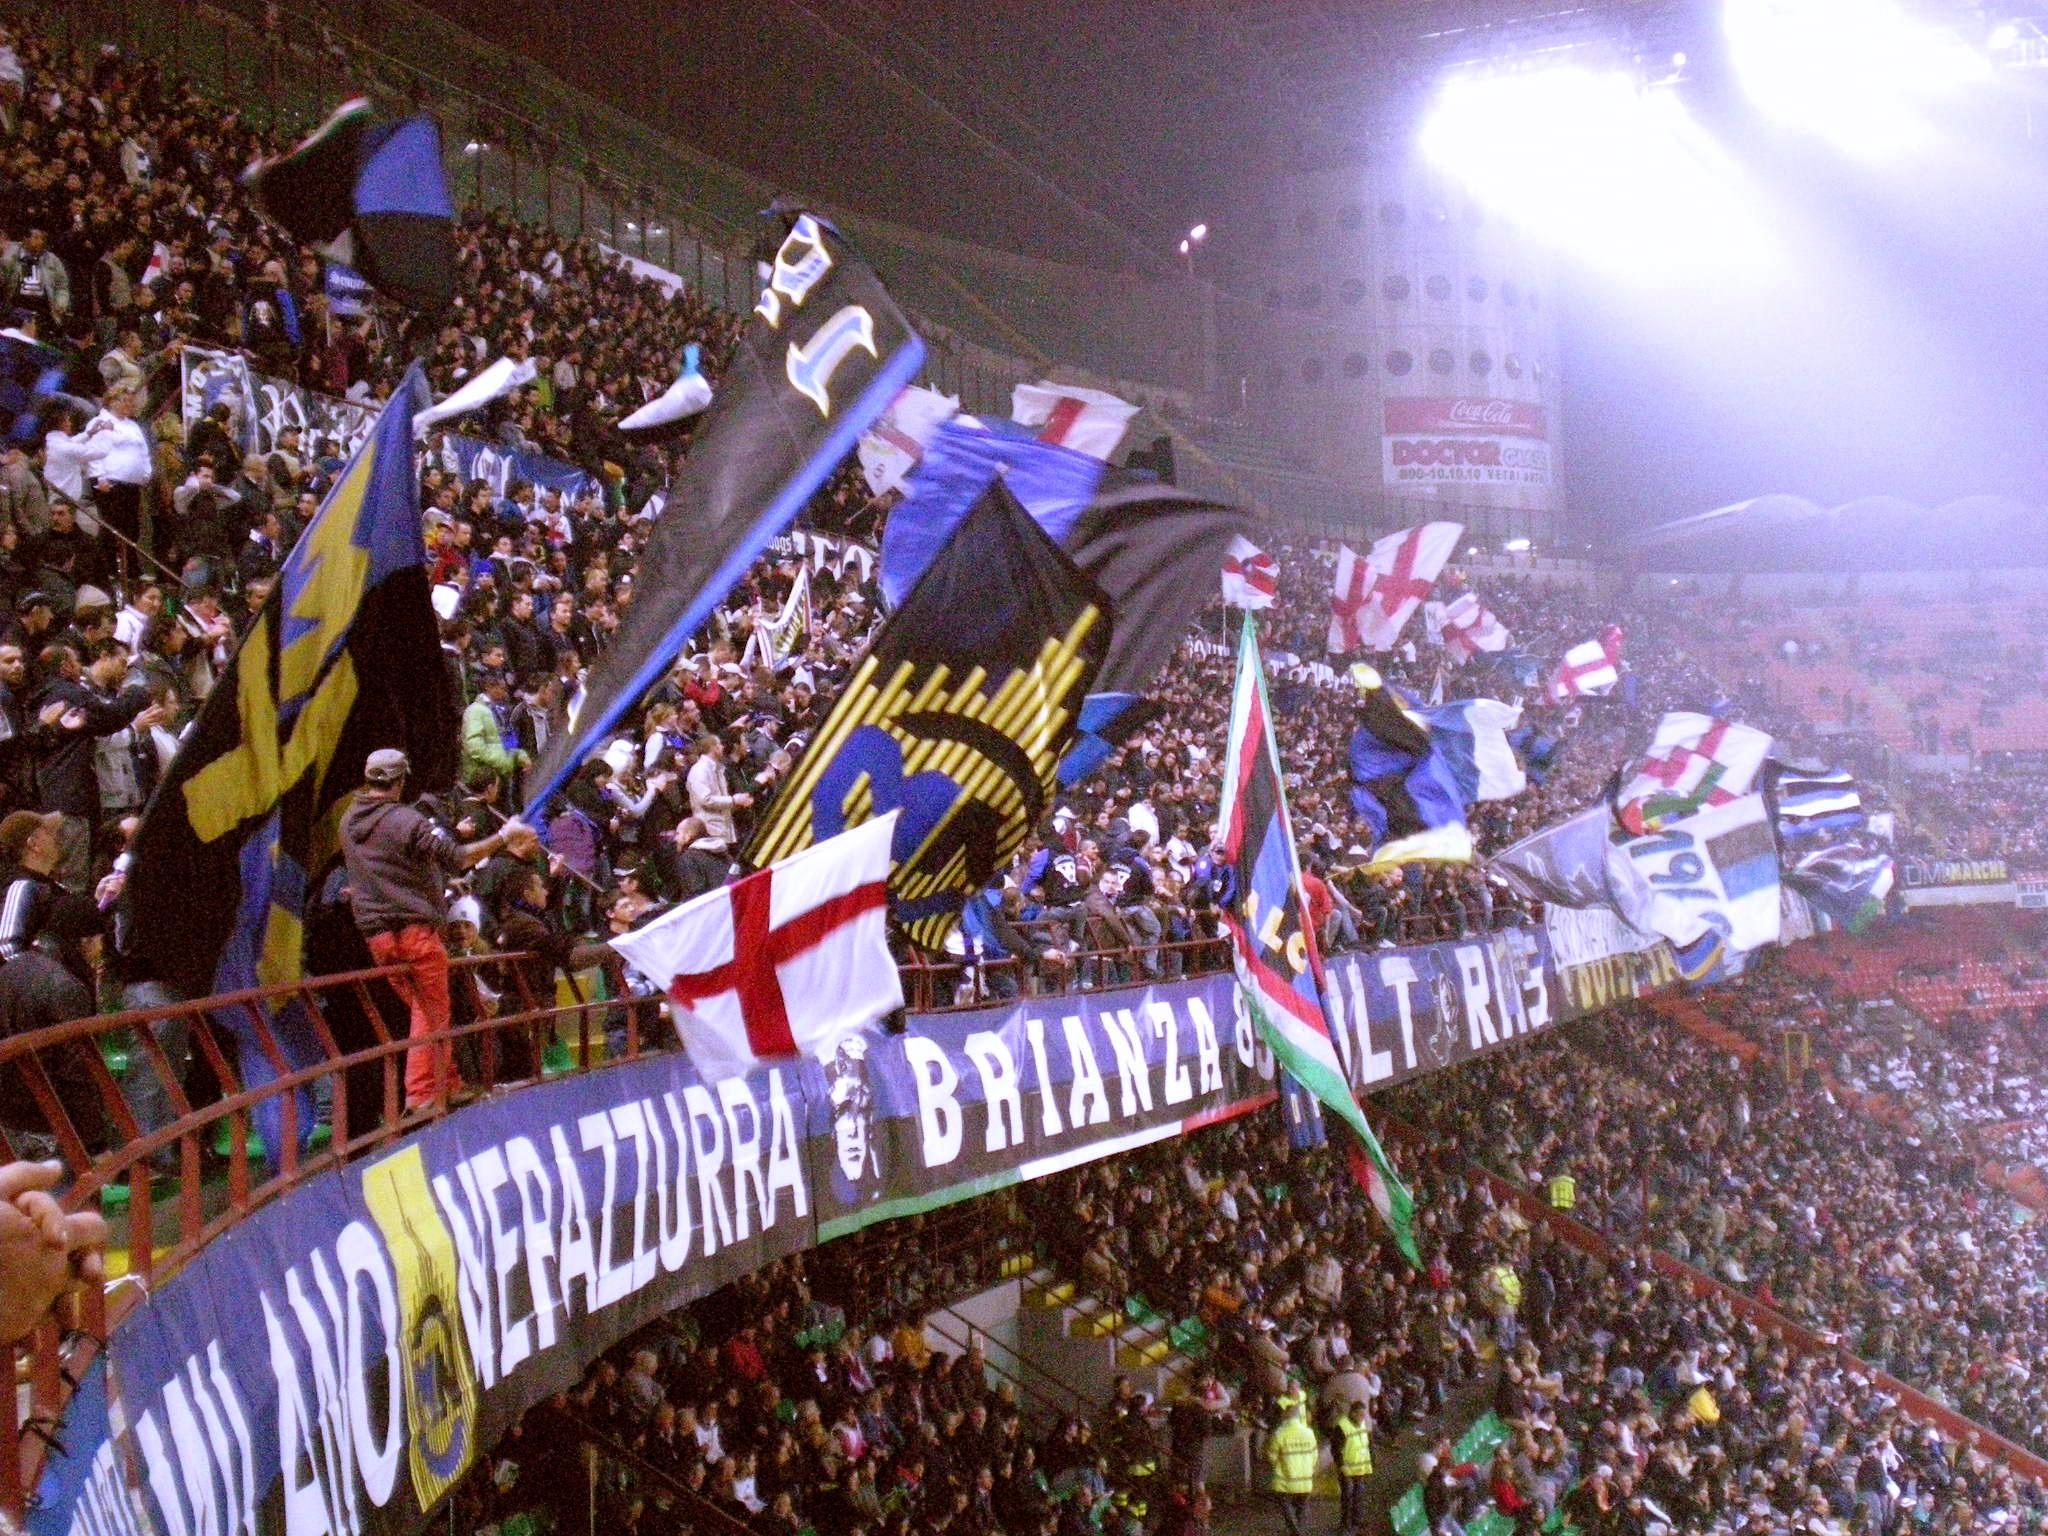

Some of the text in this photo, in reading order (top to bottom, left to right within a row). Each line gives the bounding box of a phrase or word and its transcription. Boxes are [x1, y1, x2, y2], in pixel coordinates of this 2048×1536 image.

[1392, 440, 1502, 466] DOCTOR
[905, 996, 1224, 1168] BRIANZA
[432, 1068, 808, 1391] NERAZZURRA
